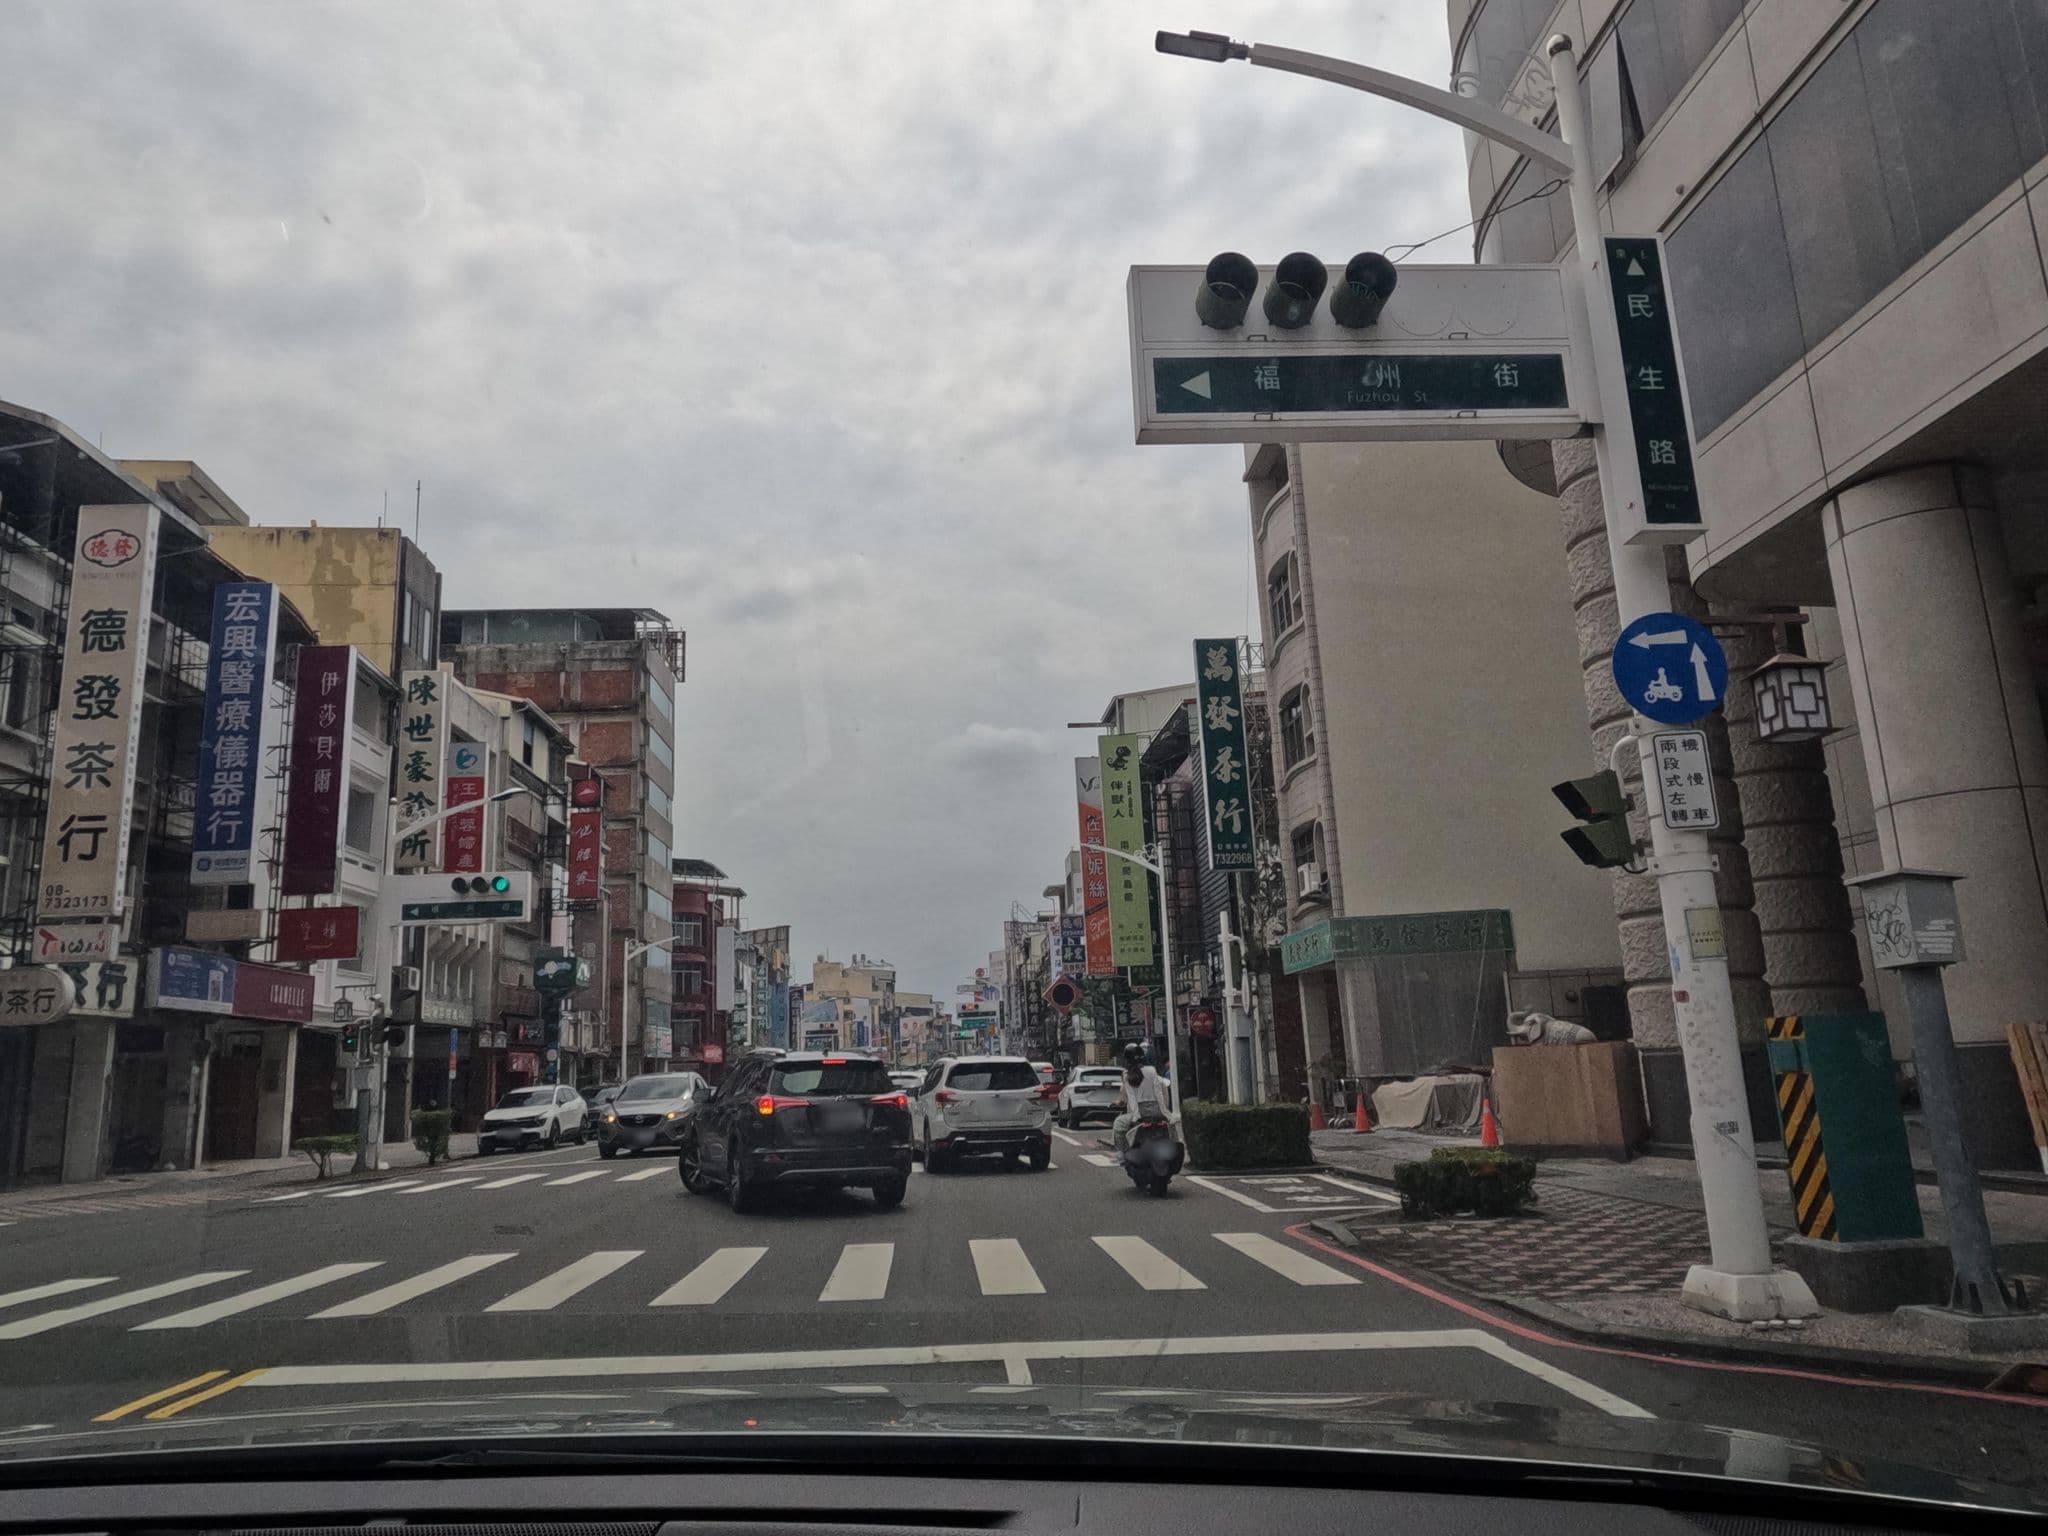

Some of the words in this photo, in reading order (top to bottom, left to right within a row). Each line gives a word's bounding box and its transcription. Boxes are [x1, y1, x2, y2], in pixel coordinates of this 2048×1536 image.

[1253, 362, 1520, 392] 福州街
[1346, 390, 1400, 404] Fuzhou
[1627, 293, 1678, 466] 民生路
[57, 607, 128, 862] 德發茶行
[206, 588, 262, 845] 宏興醫療儀器行
[314, 671, 339, 794] 伊莎貝爾
[1204, 646, 1245, 834] 萬發茶行
[1659, 739, 1689, 822] 兩段式左轉
[1681, 738, 1711, 821] 機慢車
[44, 895, 108, 909] 7323173
